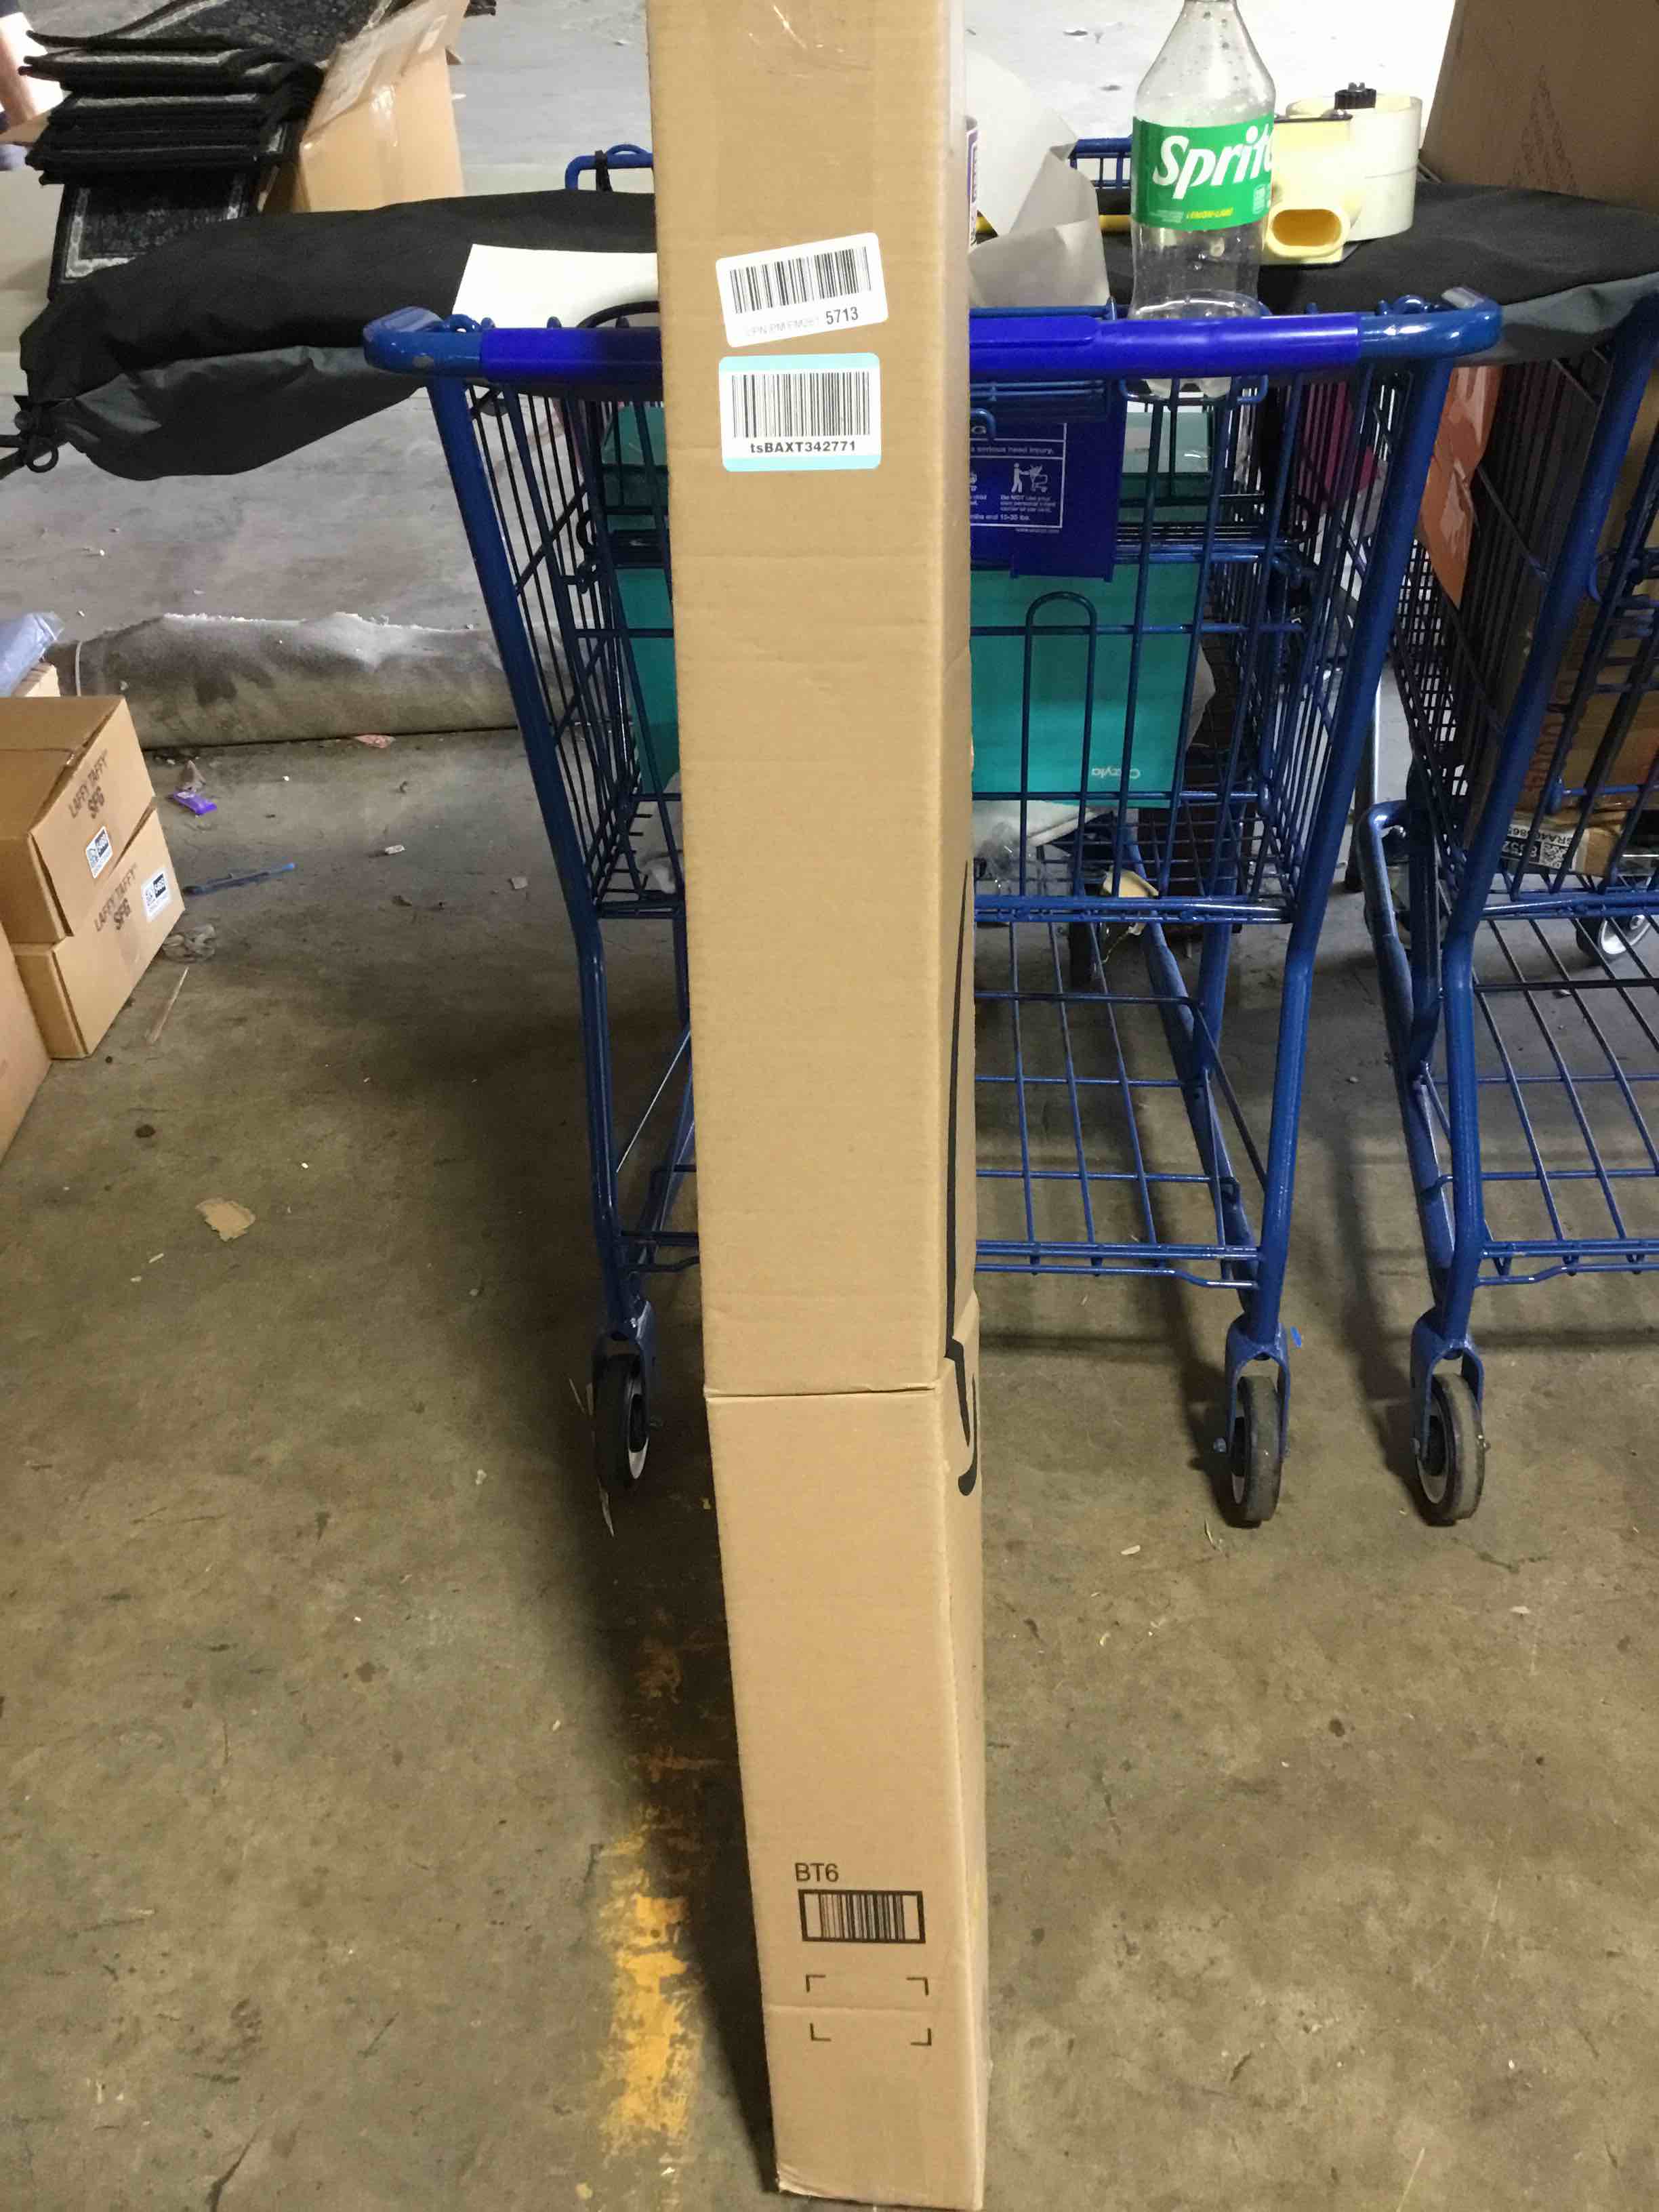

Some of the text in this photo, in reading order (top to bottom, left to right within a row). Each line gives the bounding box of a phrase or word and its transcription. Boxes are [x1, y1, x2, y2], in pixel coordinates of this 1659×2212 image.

[825, 306, 859, 325] 5713
[750, 440, 857, 454] tsBAXT342771
[795, 1862, 840, 1883] BT6
